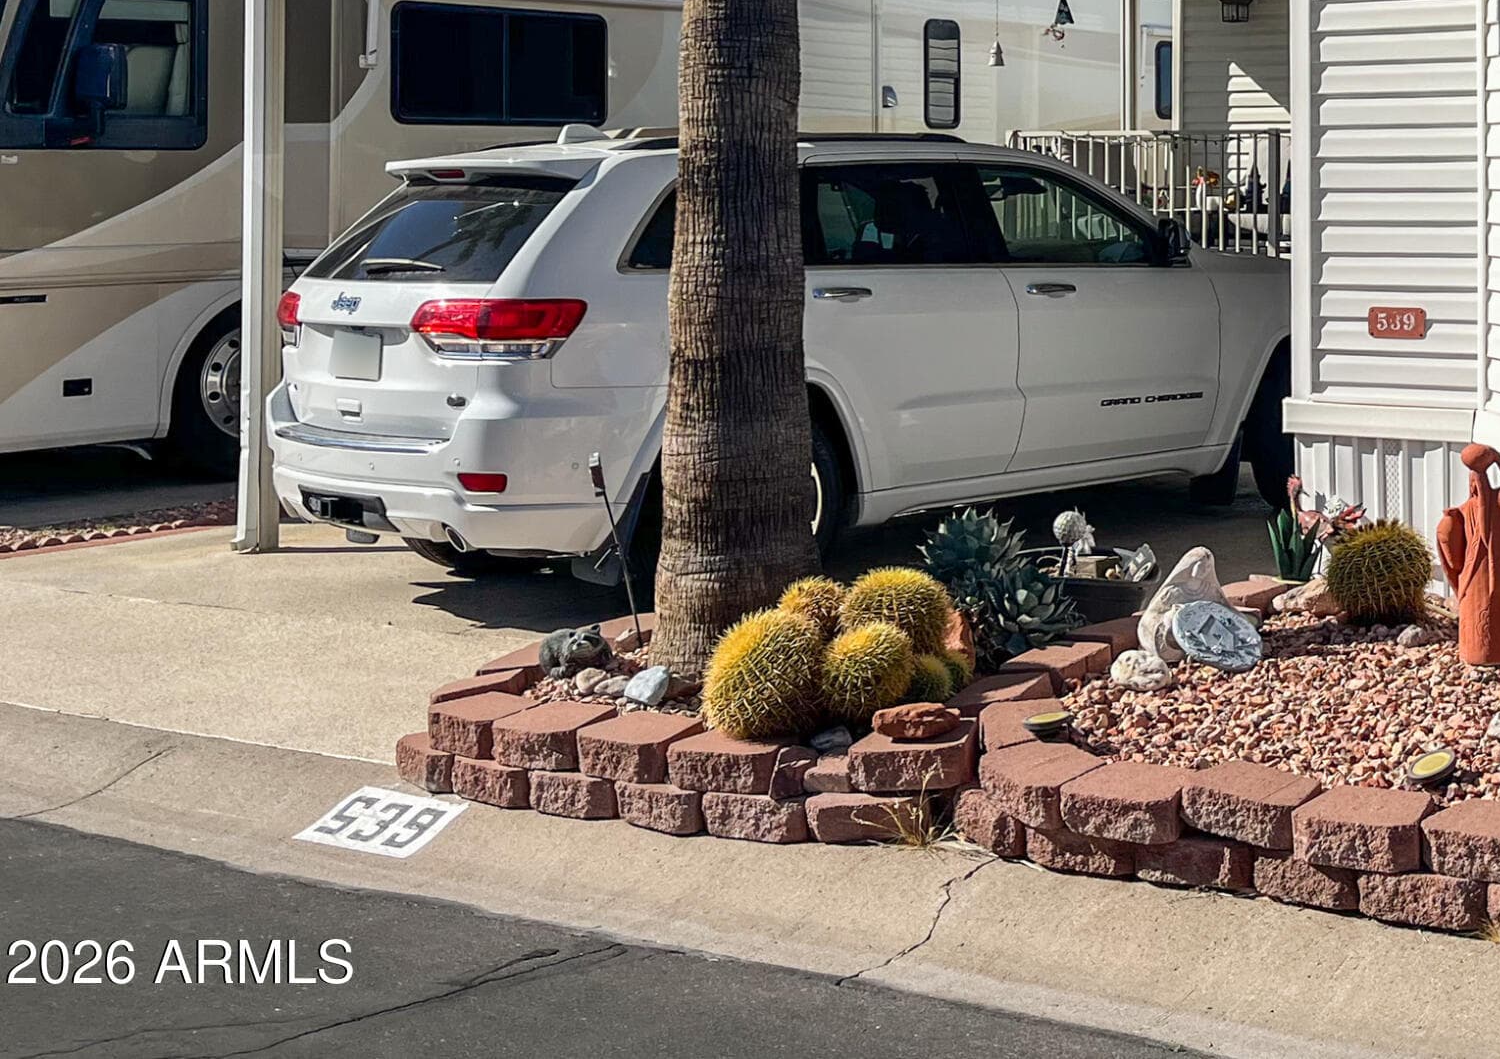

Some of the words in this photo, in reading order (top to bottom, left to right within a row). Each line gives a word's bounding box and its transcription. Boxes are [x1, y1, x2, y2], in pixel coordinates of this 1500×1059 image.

[331, 292, 361, 315] Jeep
[1376, 312, 1415, 332] 539
[1101, 397, 1141, 407] GRAND
[313, 795, 448, 848] 539
